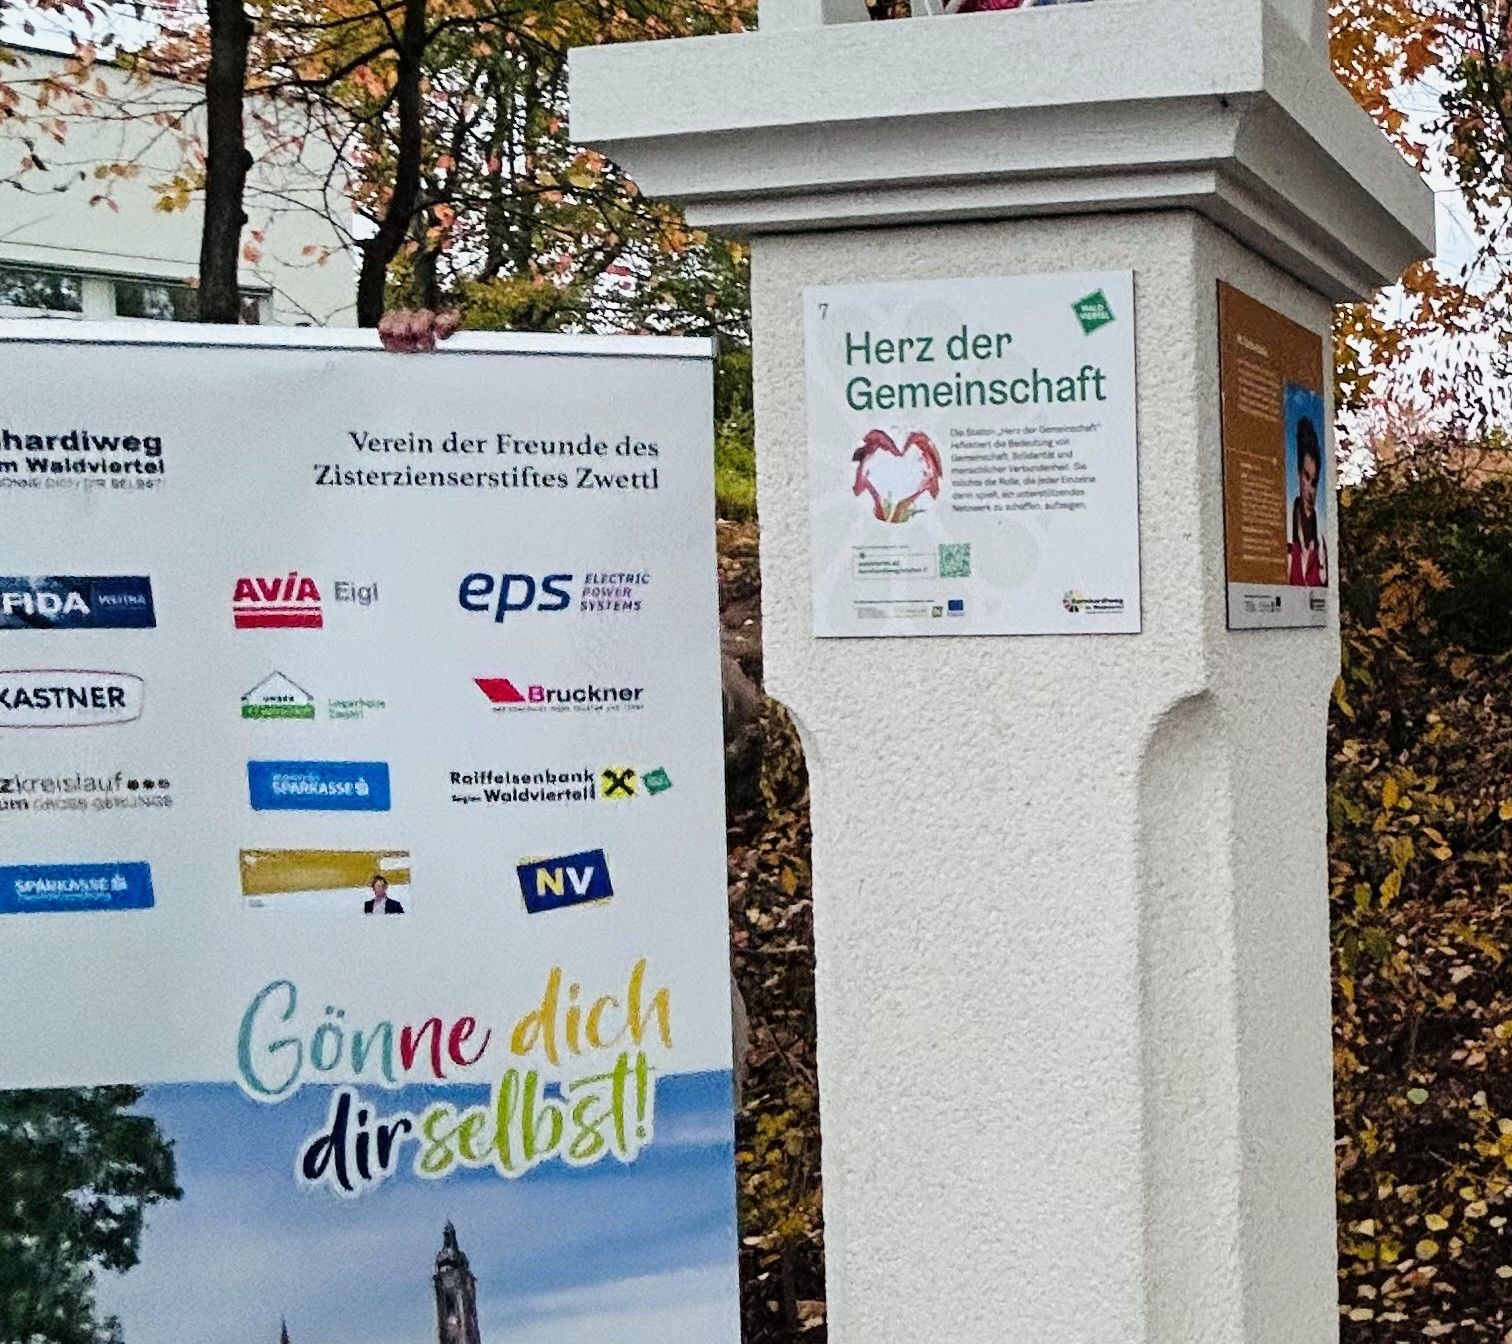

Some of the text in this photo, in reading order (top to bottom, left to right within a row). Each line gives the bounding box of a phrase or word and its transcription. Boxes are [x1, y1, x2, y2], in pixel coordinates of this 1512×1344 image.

[846, 324, 1013, 366] Herz der
[846, 364, 1107, 411] Gemeinschaft
[0, 429, 162, 457] hardiweg
[349, 432, 659, 457] Verein der Freunde des
[26, 457, 165, 474] Waldviertel
[314, 464, 659, 490] Zisterzienserstiftes Zwettl
[233, 572, 379, 606] AVIA Eigl
[458, 572, 573, 623] eps
[582, 586, 632, 597] POWER
[2, 592, 91, 616] FIDA
[580, 600, 642, 612] SYSTEMS
[528, 684, 644, 703] Bruckner
[450, 769, 594, 785] Raiffeisenbank
[535, 866, 594, 896] NV
[237, 958, 673, 1096] Gönne dich
[302, 1051, 657, 1192] dir selbst!
